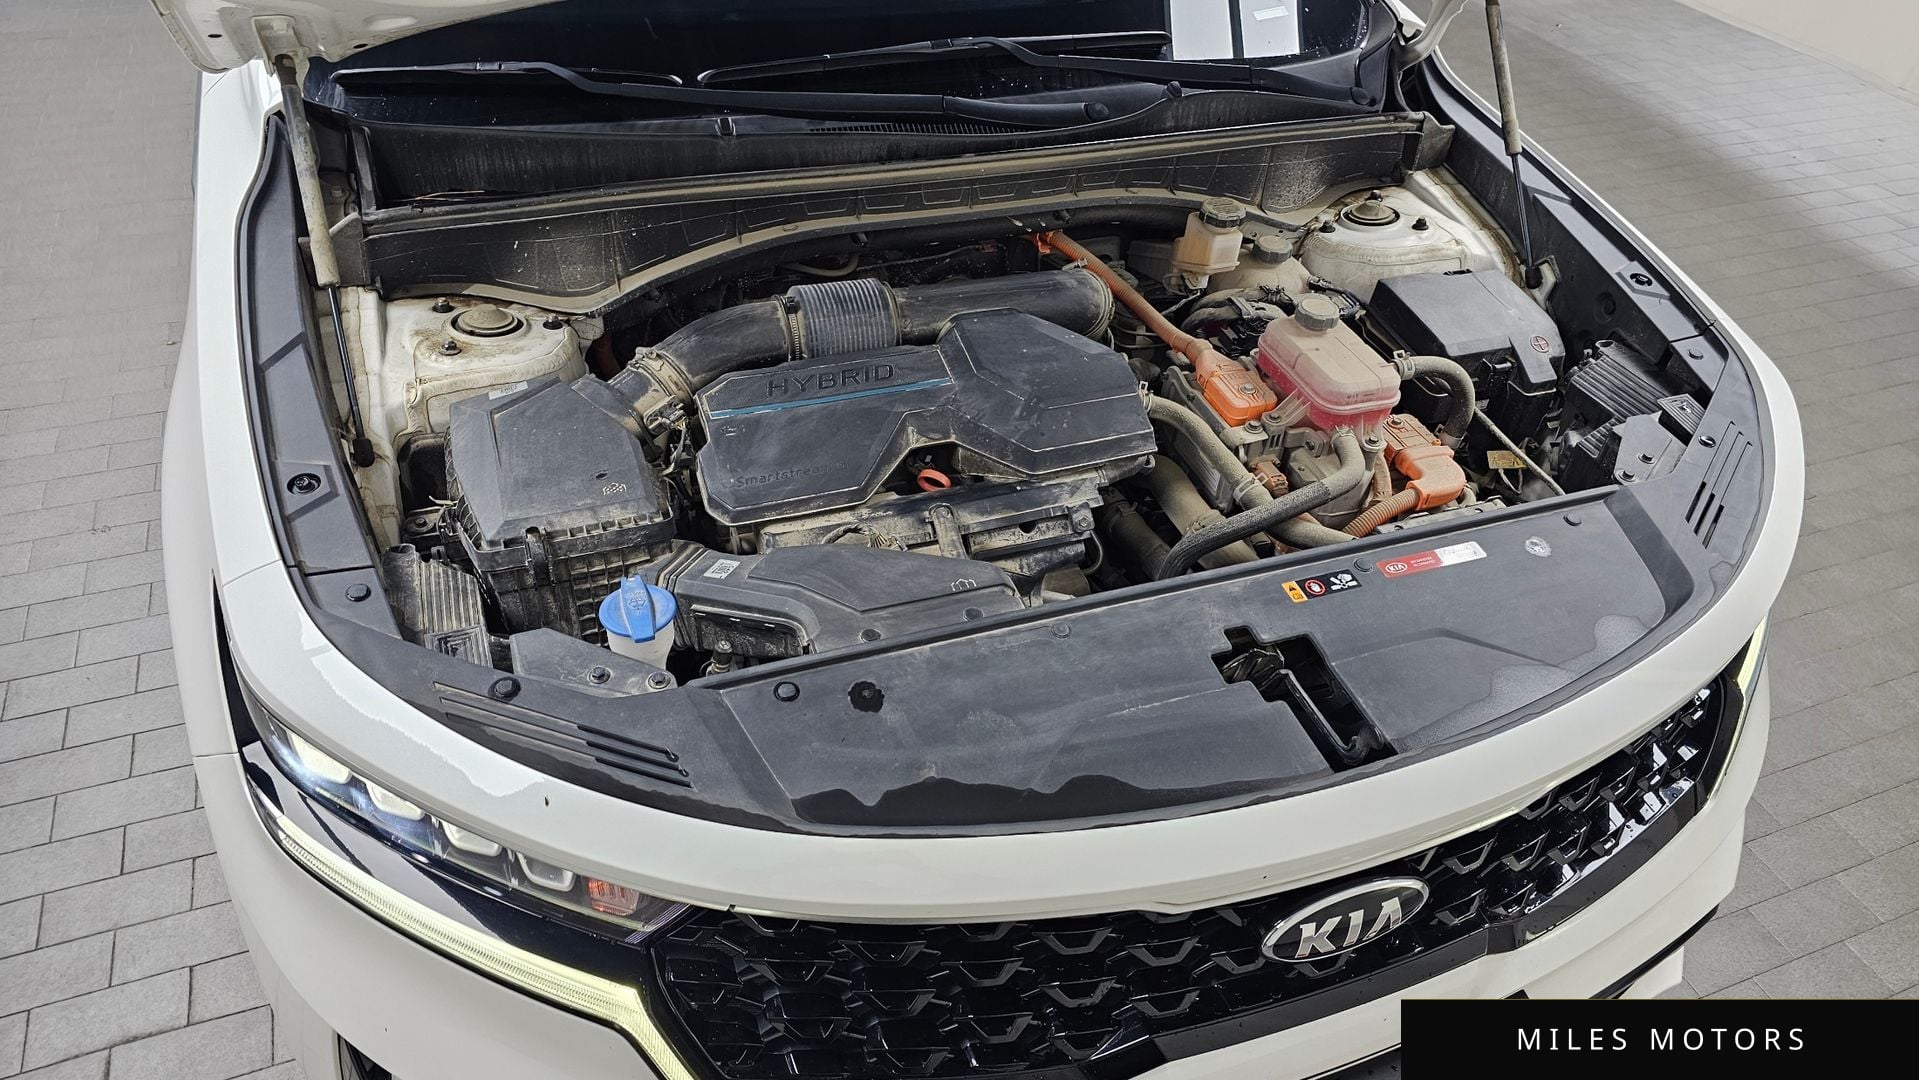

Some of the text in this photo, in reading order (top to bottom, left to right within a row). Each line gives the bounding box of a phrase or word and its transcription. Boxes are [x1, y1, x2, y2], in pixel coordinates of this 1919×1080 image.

[766, 364, 895, 397] HYBRID
[736, 463, 833, 488] Smartstream
[1387, 563, 1406, 573] KIA
[1295, 896, 1402, 959] KIA
